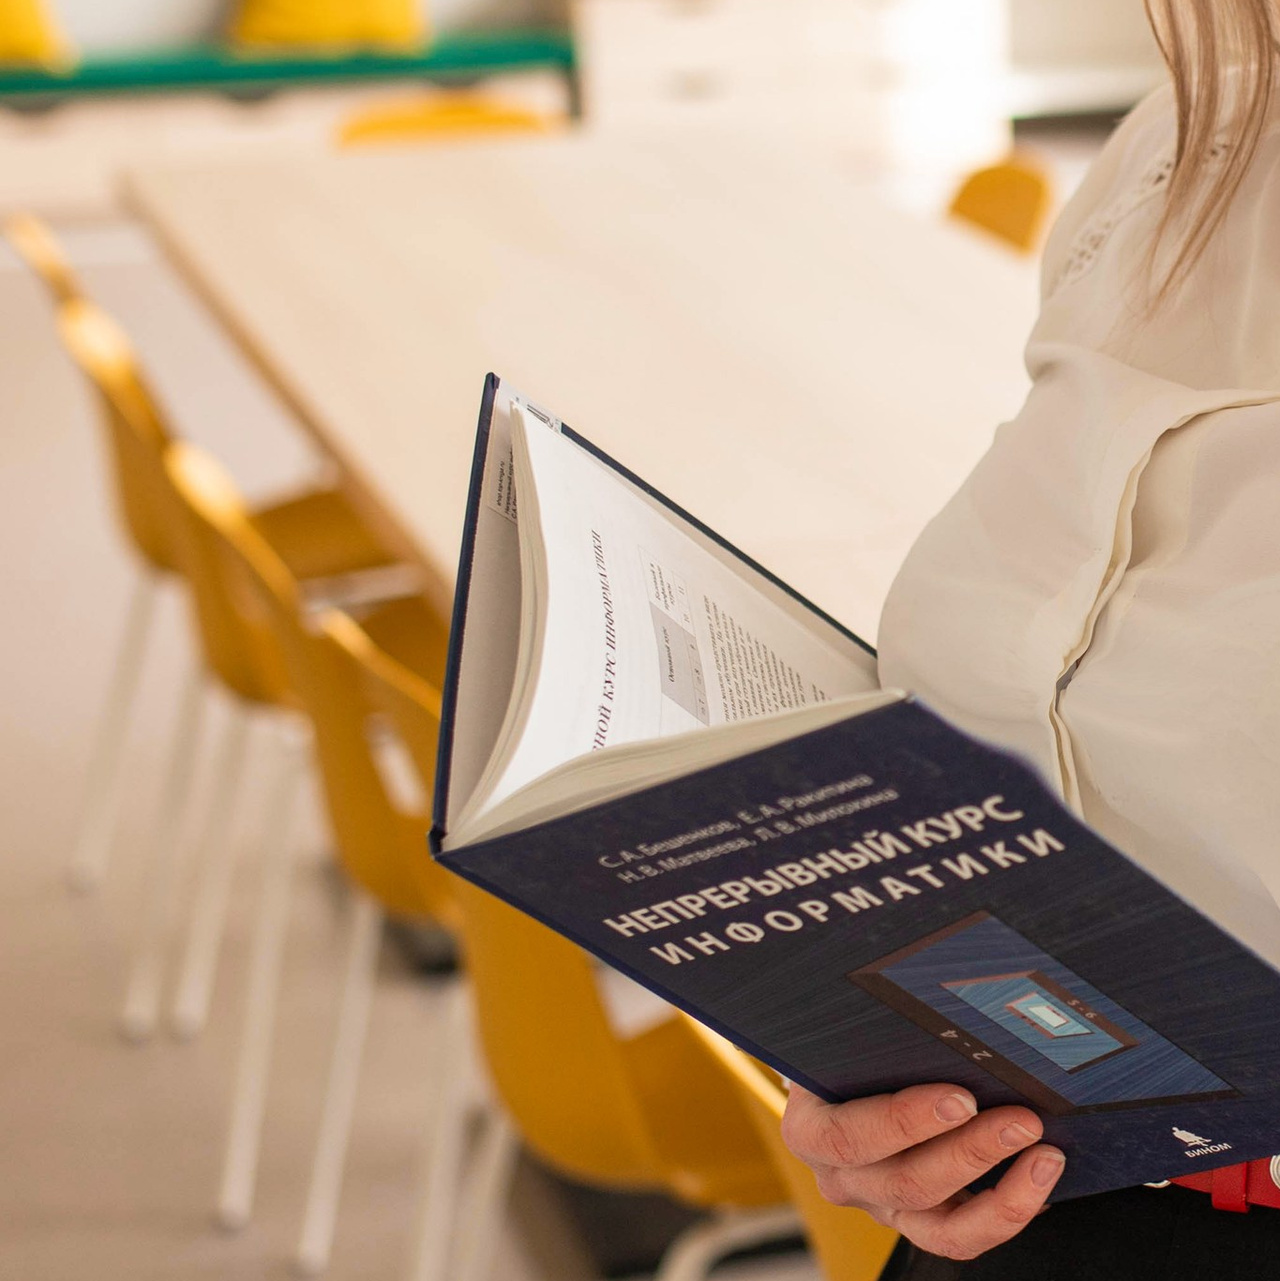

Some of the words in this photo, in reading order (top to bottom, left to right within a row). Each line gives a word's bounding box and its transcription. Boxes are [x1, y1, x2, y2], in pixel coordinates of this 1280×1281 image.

[591, 529, 616, 652] ИНФОРМАТИКИ
[602, 653, 616, 700] КУРС
[665, 644, 675, 683] Основной
[637, 820, 742, 857] Бешенков,
[777, 773, 874, 811] Ракитина
[603, 829, 909, 937] НЕПРЕРЫВНЫЙ
[901, 794, 1024, 849] КУРС
[657, 837, 757, 871] Матвеева,
[649, 827, 1066, 966] ИНФОРМАТИКИ
[1184, 1142, 1233, 1158] БИНОМ
